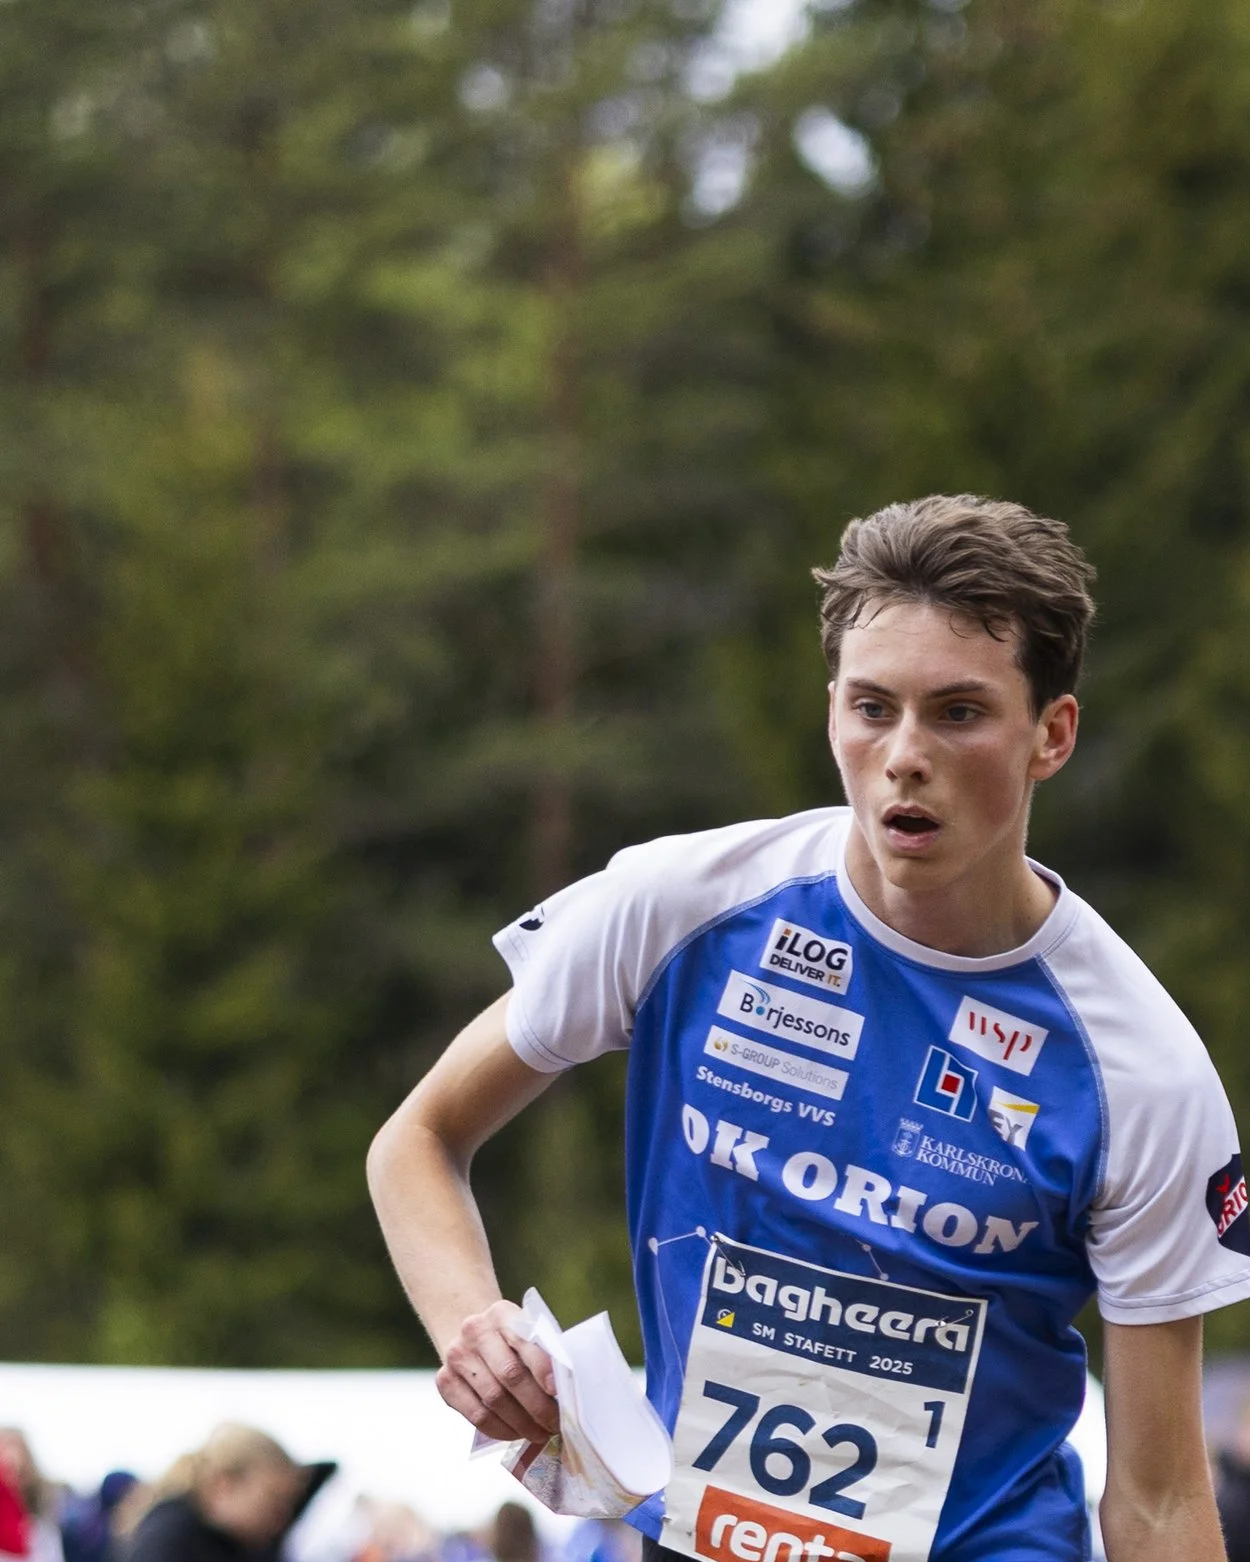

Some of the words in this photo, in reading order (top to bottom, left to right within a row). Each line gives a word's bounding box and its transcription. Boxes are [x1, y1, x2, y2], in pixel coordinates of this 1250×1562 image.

[769, 954, 825, 981] DELIVER
[775, 928, 848, 970] iLOG
[730, 1043, 780, 1069] S-GROUP
[781, 1062, 838, 1091] Solutions
[696, 1066, 793, 1113] Stensborgs
[798, 1102, 836, 1126] VVS
[681, 1103, 770, 1182] OK
[782, 1151, 1040, 1254] ORION
[916, 1148, 998, 1187] KOMMUN
[711, 1256, 969, 1353] bagheera
[752, 1323, 775, 1341] SM
[784, 1333, 857, 1363] STAFETT
[869, 1355, 913, 1375] 2025
[691, 1380, 878, 1520] 762
[923, 1401, 945, 1449] 1
